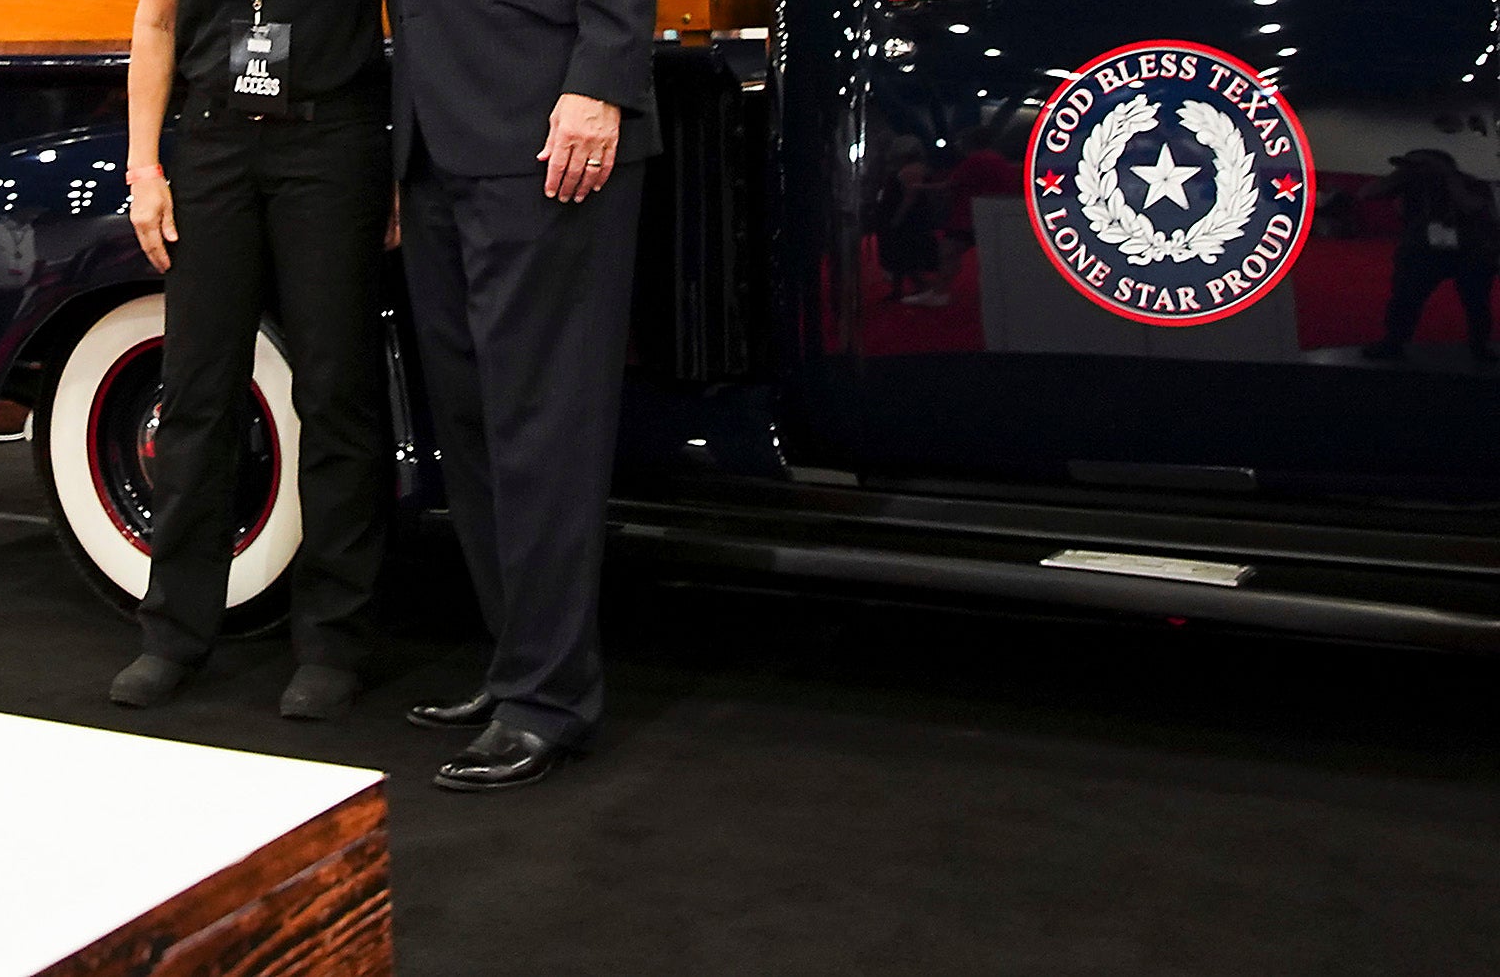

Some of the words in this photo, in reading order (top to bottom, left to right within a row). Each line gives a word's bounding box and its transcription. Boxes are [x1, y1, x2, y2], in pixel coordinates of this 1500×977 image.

[234, 75, 280, 96] ACCESS
[246, 58, 269, 77] ALL
[1046, 88, 1095, 154] GOD
[1095, 53, 1199, 95] BLESS
[1209, 63, 1291, 158] TEXAS
[1044, 208, 1111, 287] LONE
[1113, 277, 1200, 312] STAR
[1206, 213, 1294, 304] PROUD
